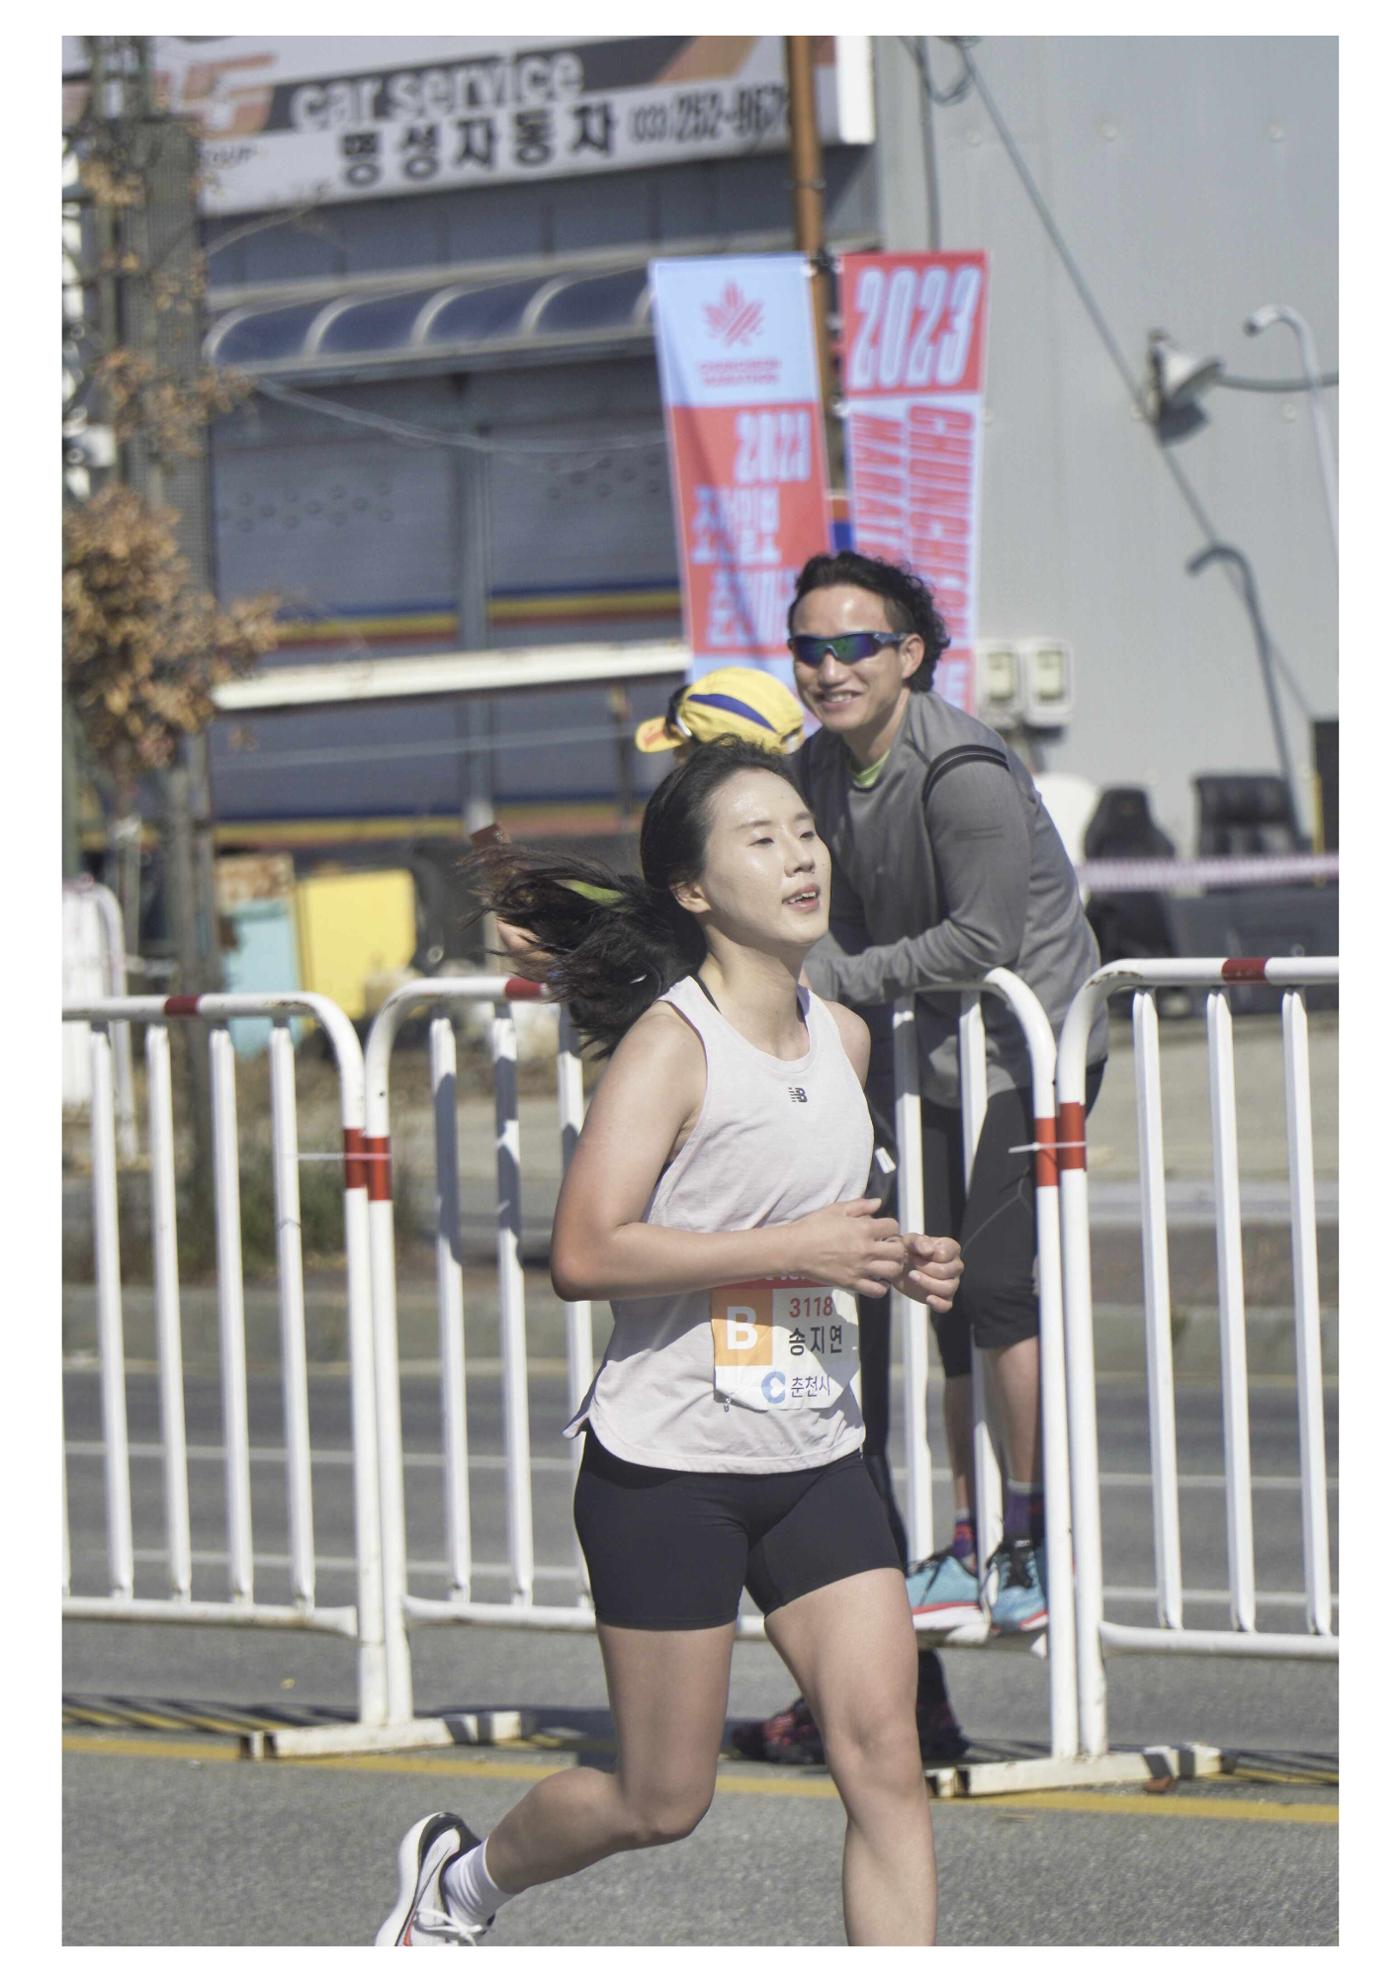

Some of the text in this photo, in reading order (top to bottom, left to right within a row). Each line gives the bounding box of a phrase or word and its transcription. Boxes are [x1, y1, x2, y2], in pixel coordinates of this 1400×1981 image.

[292, 76, 382, 130] car
[388, 50, 584, 118] service
[341, 103, 616, 186] 명성자동차
[851, 264, 982, 389] 2023
[726, 1305, 758, 1350] B
[789, 1296, 834, 1318] 3118
[789, 1324, 843, 1356] 송지연
[790, 1374, 832, 1398] 춘천시
